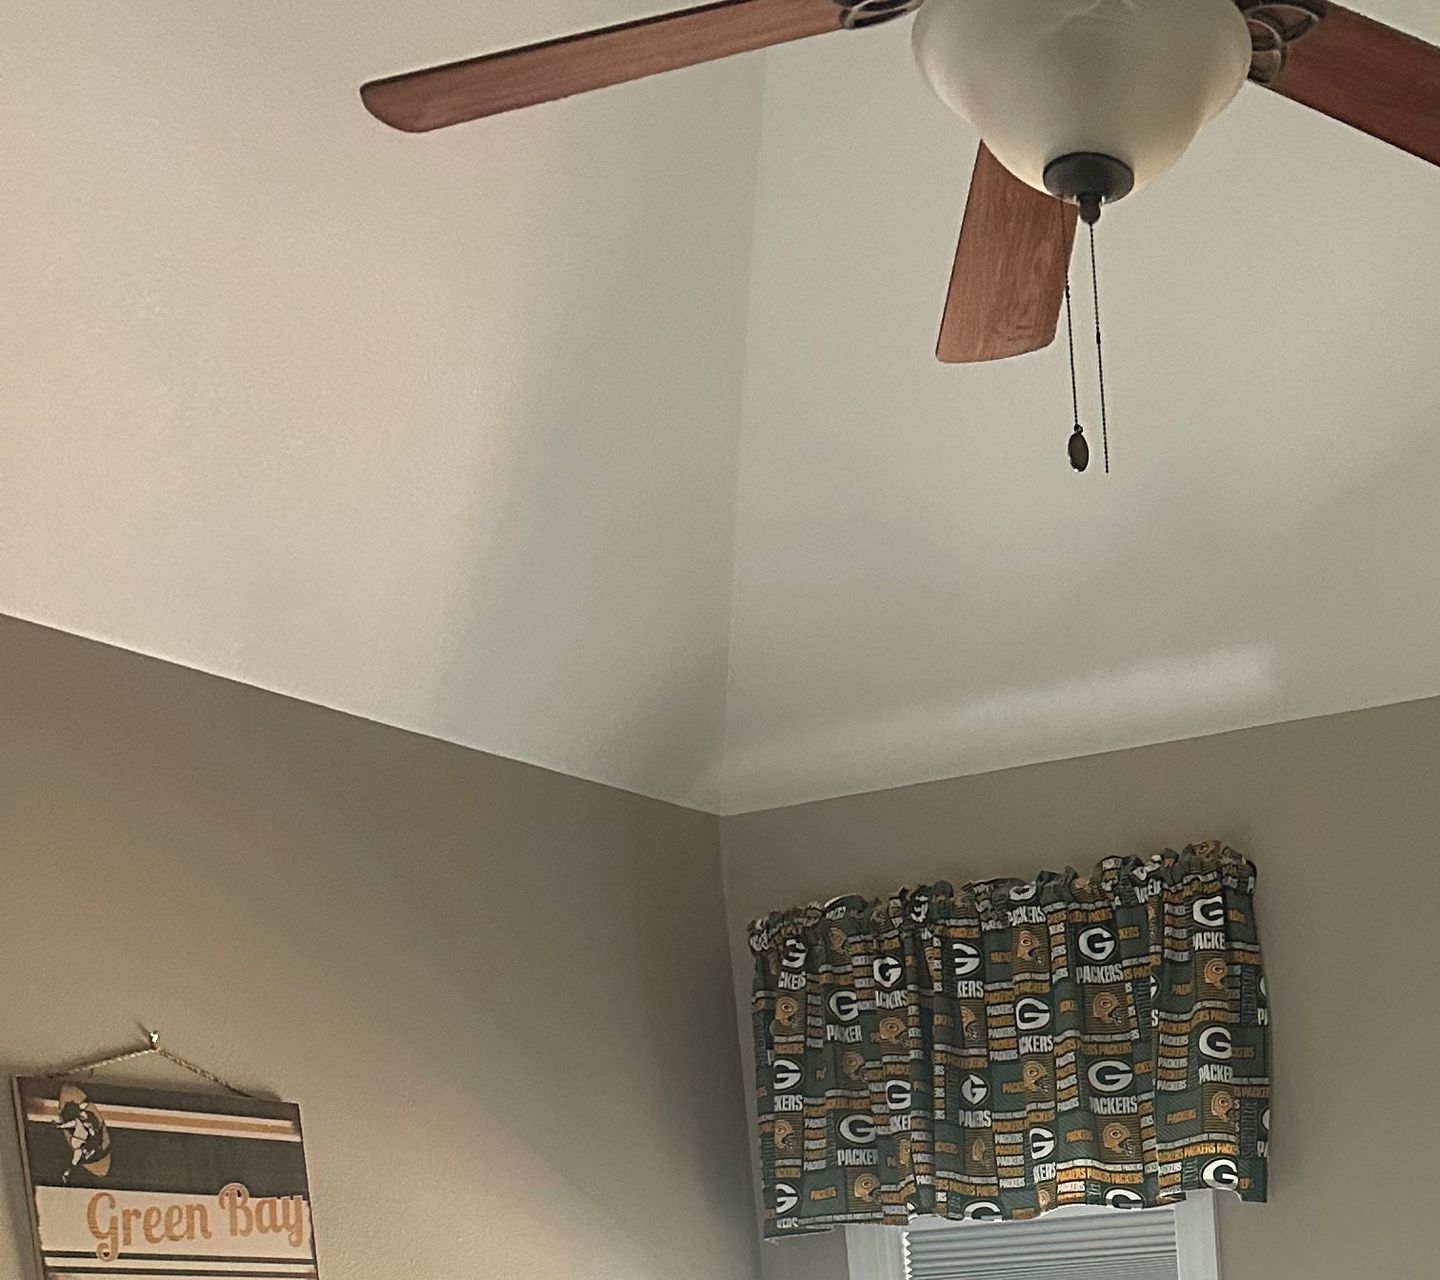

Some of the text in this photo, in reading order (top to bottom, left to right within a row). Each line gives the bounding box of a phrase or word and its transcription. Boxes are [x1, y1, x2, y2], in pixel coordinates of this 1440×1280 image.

[1075, 964, 1124, 985] PACKERS
[1087, 1060, 1133, 1092] G
[87, 1182, 304, 1262] Green Bay
